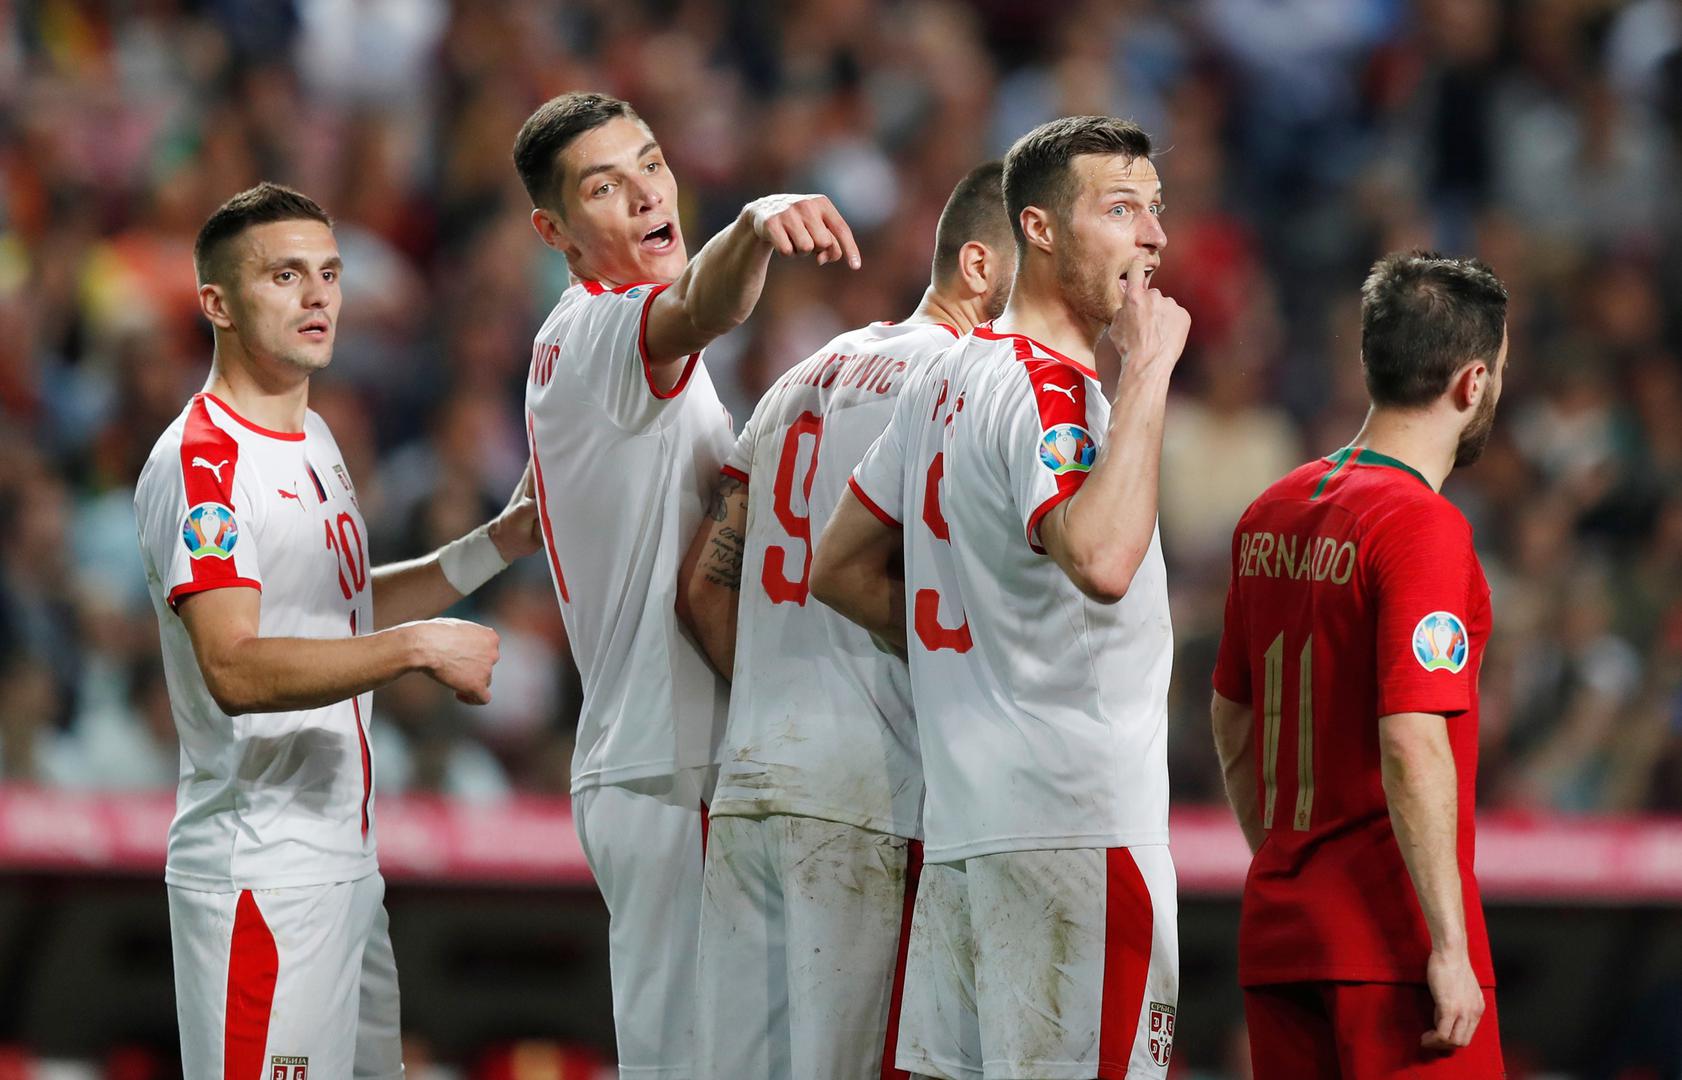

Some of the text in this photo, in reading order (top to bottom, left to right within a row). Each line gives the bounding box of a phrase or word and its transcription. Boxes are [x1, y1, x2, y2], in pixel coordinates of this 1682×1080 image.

[324, 511, 366, 600] 10
[761, 410, 824, 607] 9
[1263, 630, 1315, 832] 11
